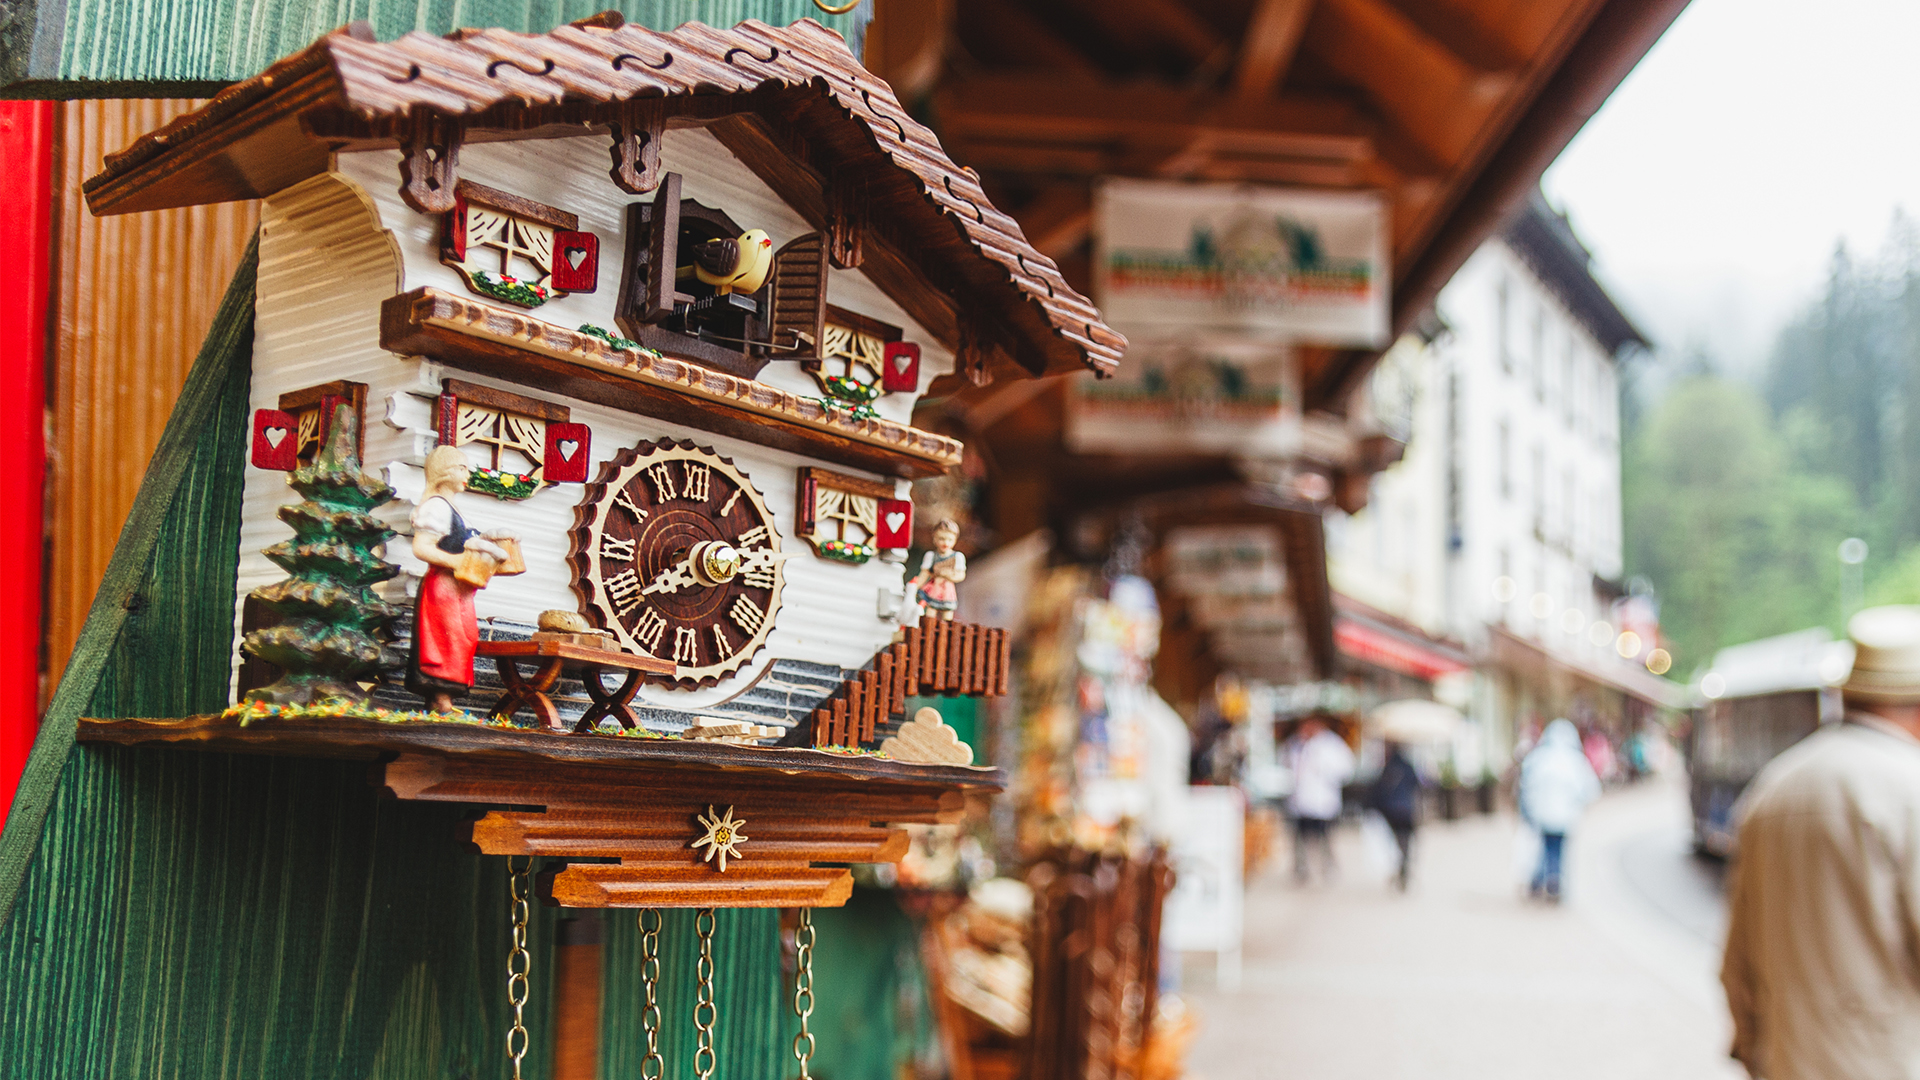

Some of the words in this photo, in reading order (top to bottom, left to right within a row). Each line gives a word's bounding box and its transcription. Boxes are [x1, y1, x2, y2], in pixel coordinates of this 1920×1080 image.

[614, 487, 649, 523] X
[720, 488, 742, 517] I
[600, 533, 636, 562] IX
[738, 526, 769, 548] II
[730, 593, 766, 637] IIII
[713, 623, 733, 663] V
